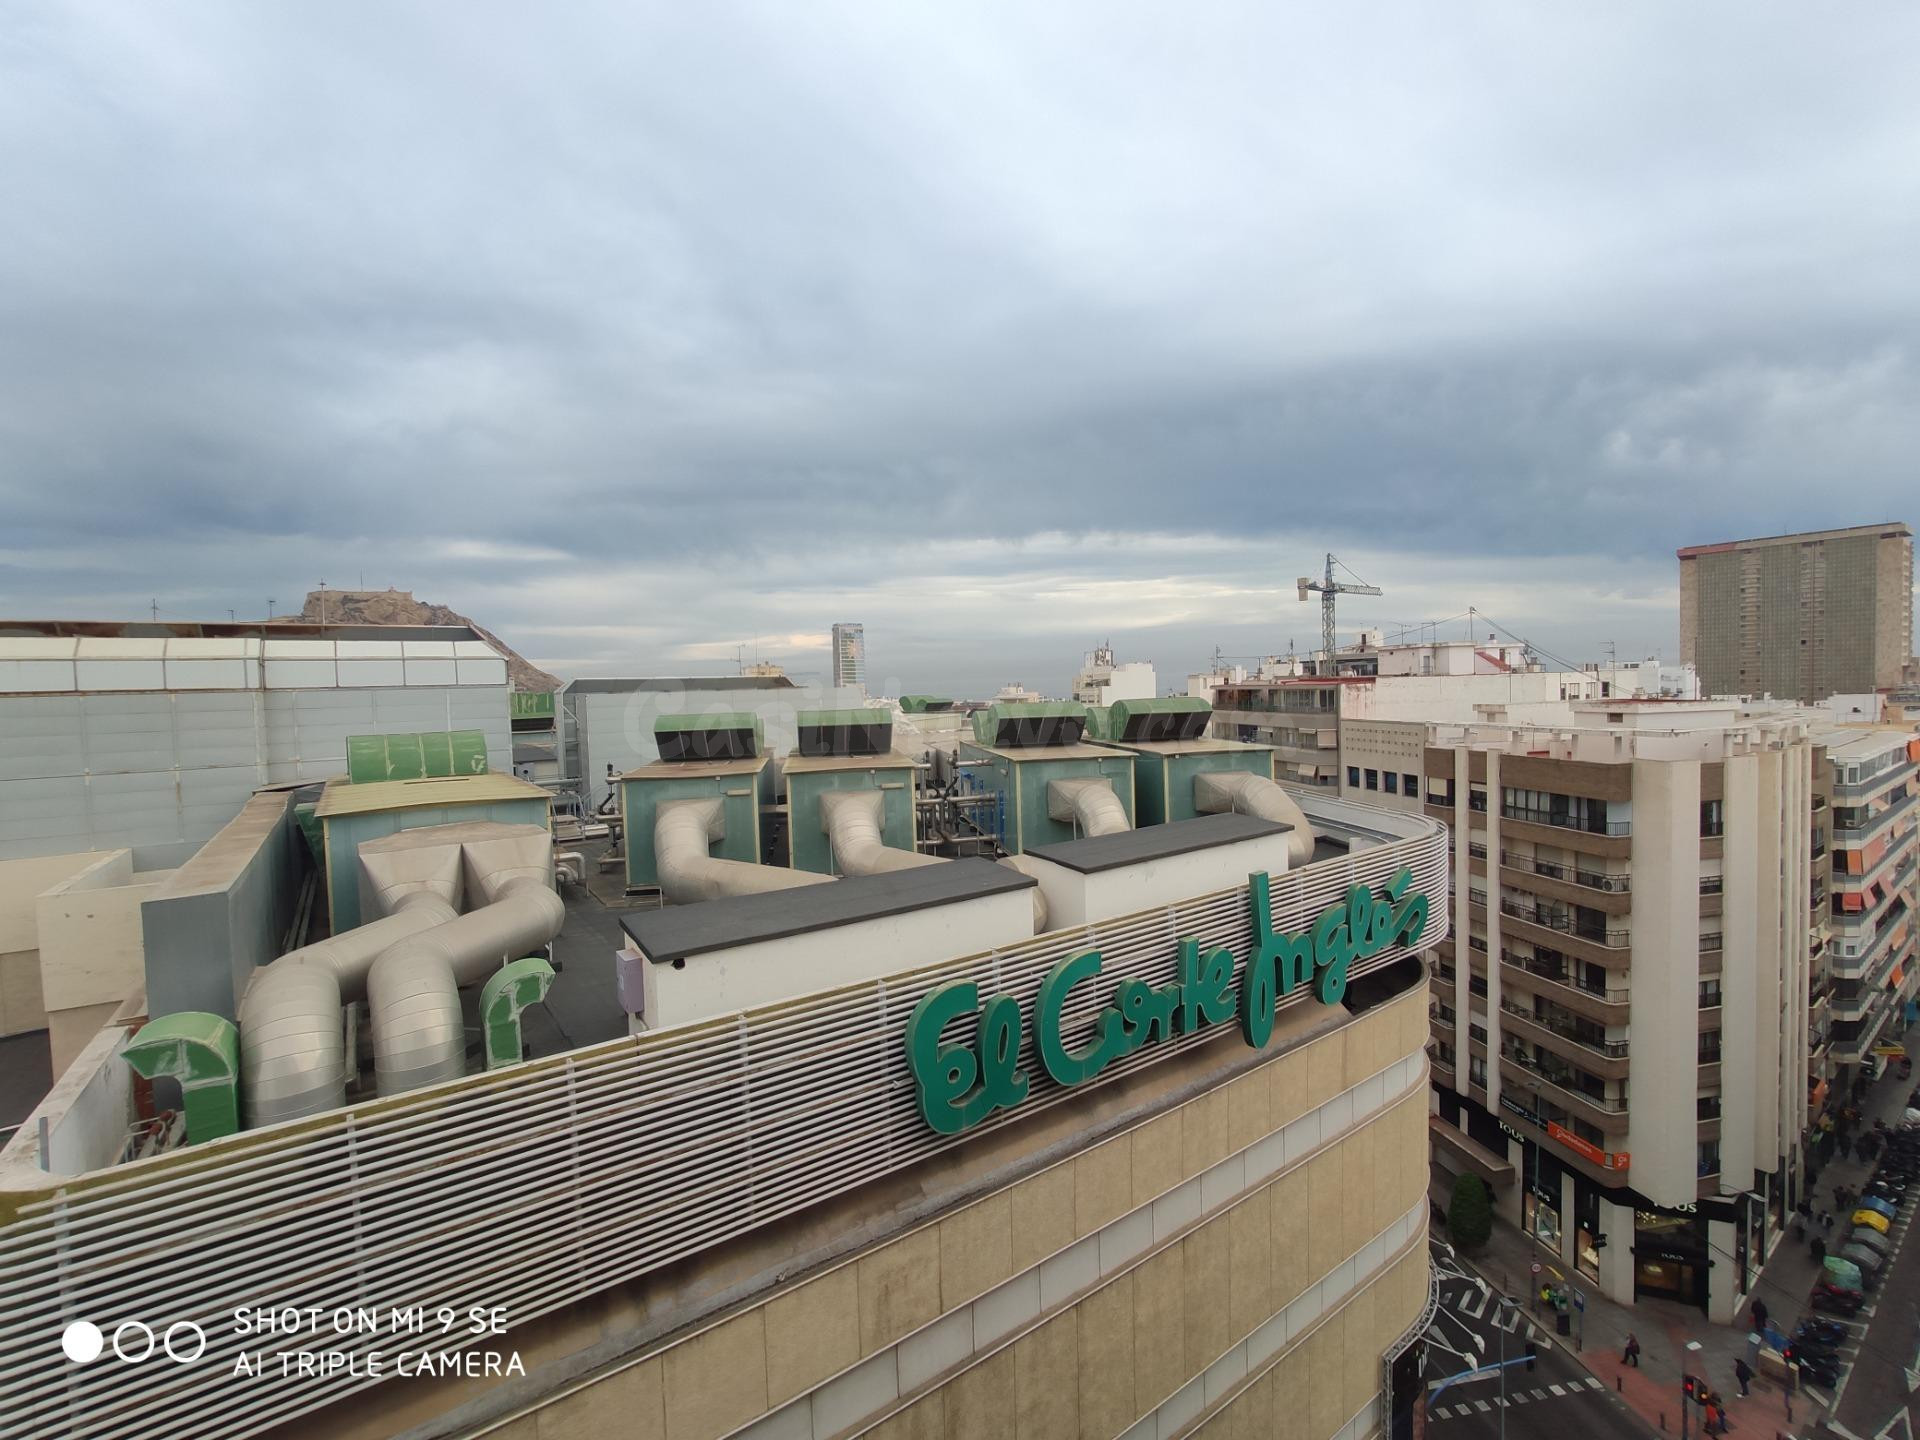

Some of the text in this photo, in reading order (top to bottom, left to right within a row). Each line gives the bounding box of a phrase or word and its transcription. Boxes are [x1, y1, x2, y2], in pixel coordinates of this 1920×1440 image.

[905, 865, 1429, 1135] El Corte Inglés
[1498, 1120, 1525, 1143] TOUS
[1654, 1202, 1698, 1213] US
